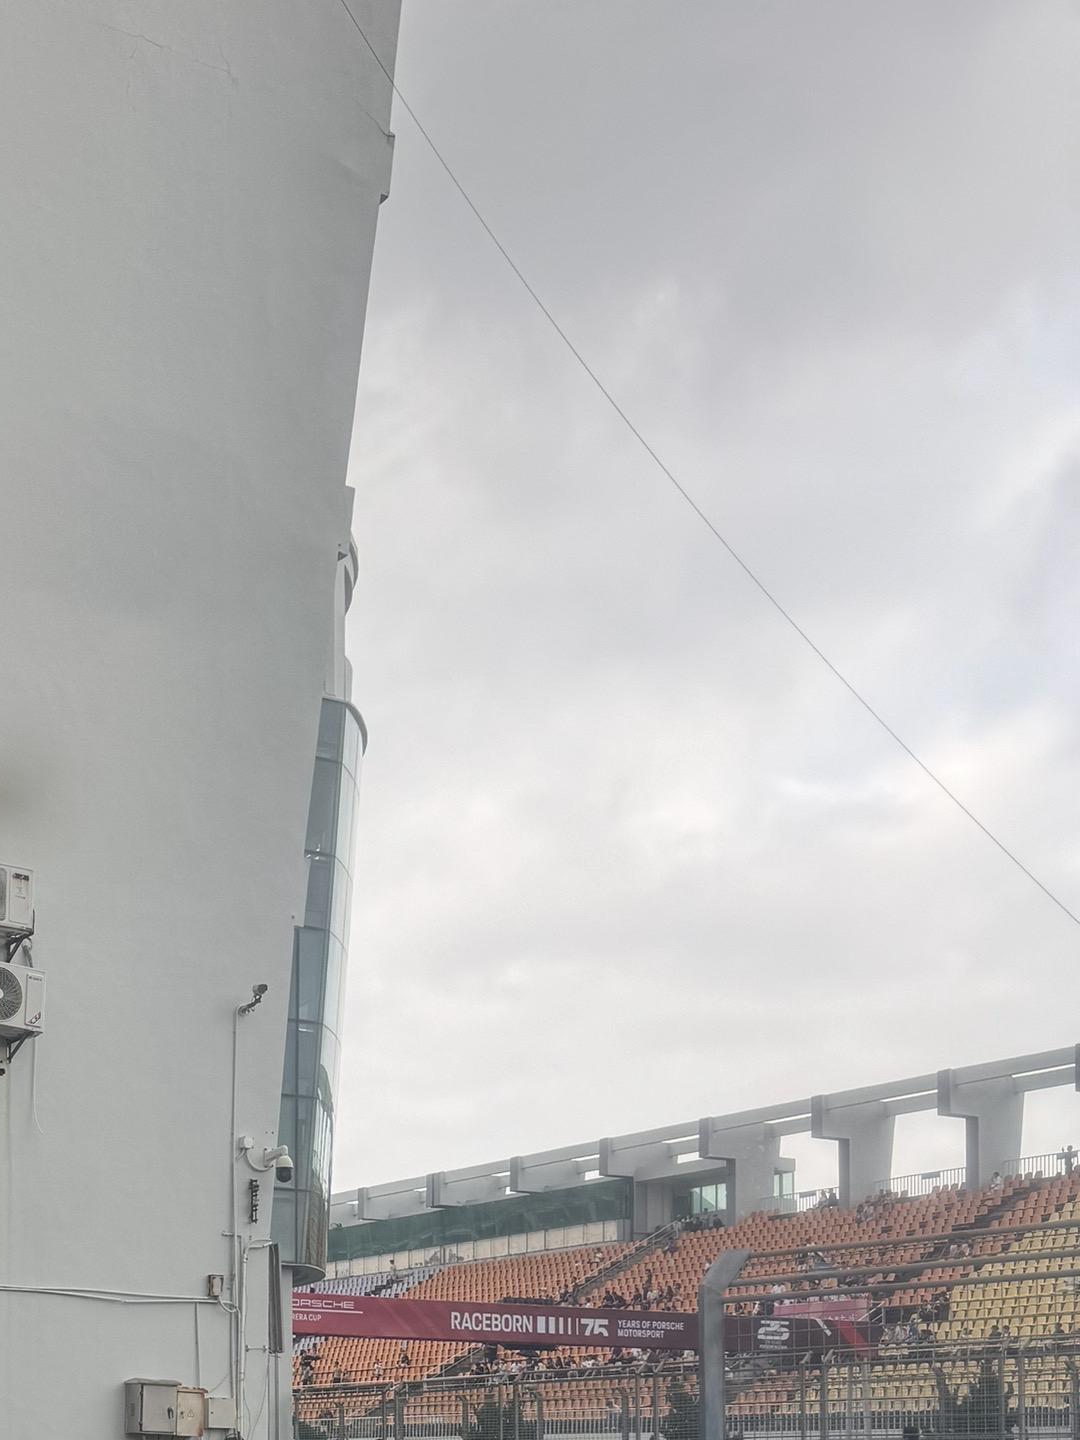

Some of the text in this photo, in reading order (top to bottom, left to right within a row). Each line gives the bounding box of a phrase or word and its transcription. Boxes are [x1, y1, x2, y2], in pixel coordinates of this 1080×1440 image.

[292, 1298, 354, 1309] ORSCHE
[292, 1312, 322, 1322] RERA CUP
[450, 1311, 609, 1337] RACEBORN 75
[617, 1319, 684, 1331] YEARS OF PORSCHE
[617, 1329, 664, 1338] MOTORSPORT
